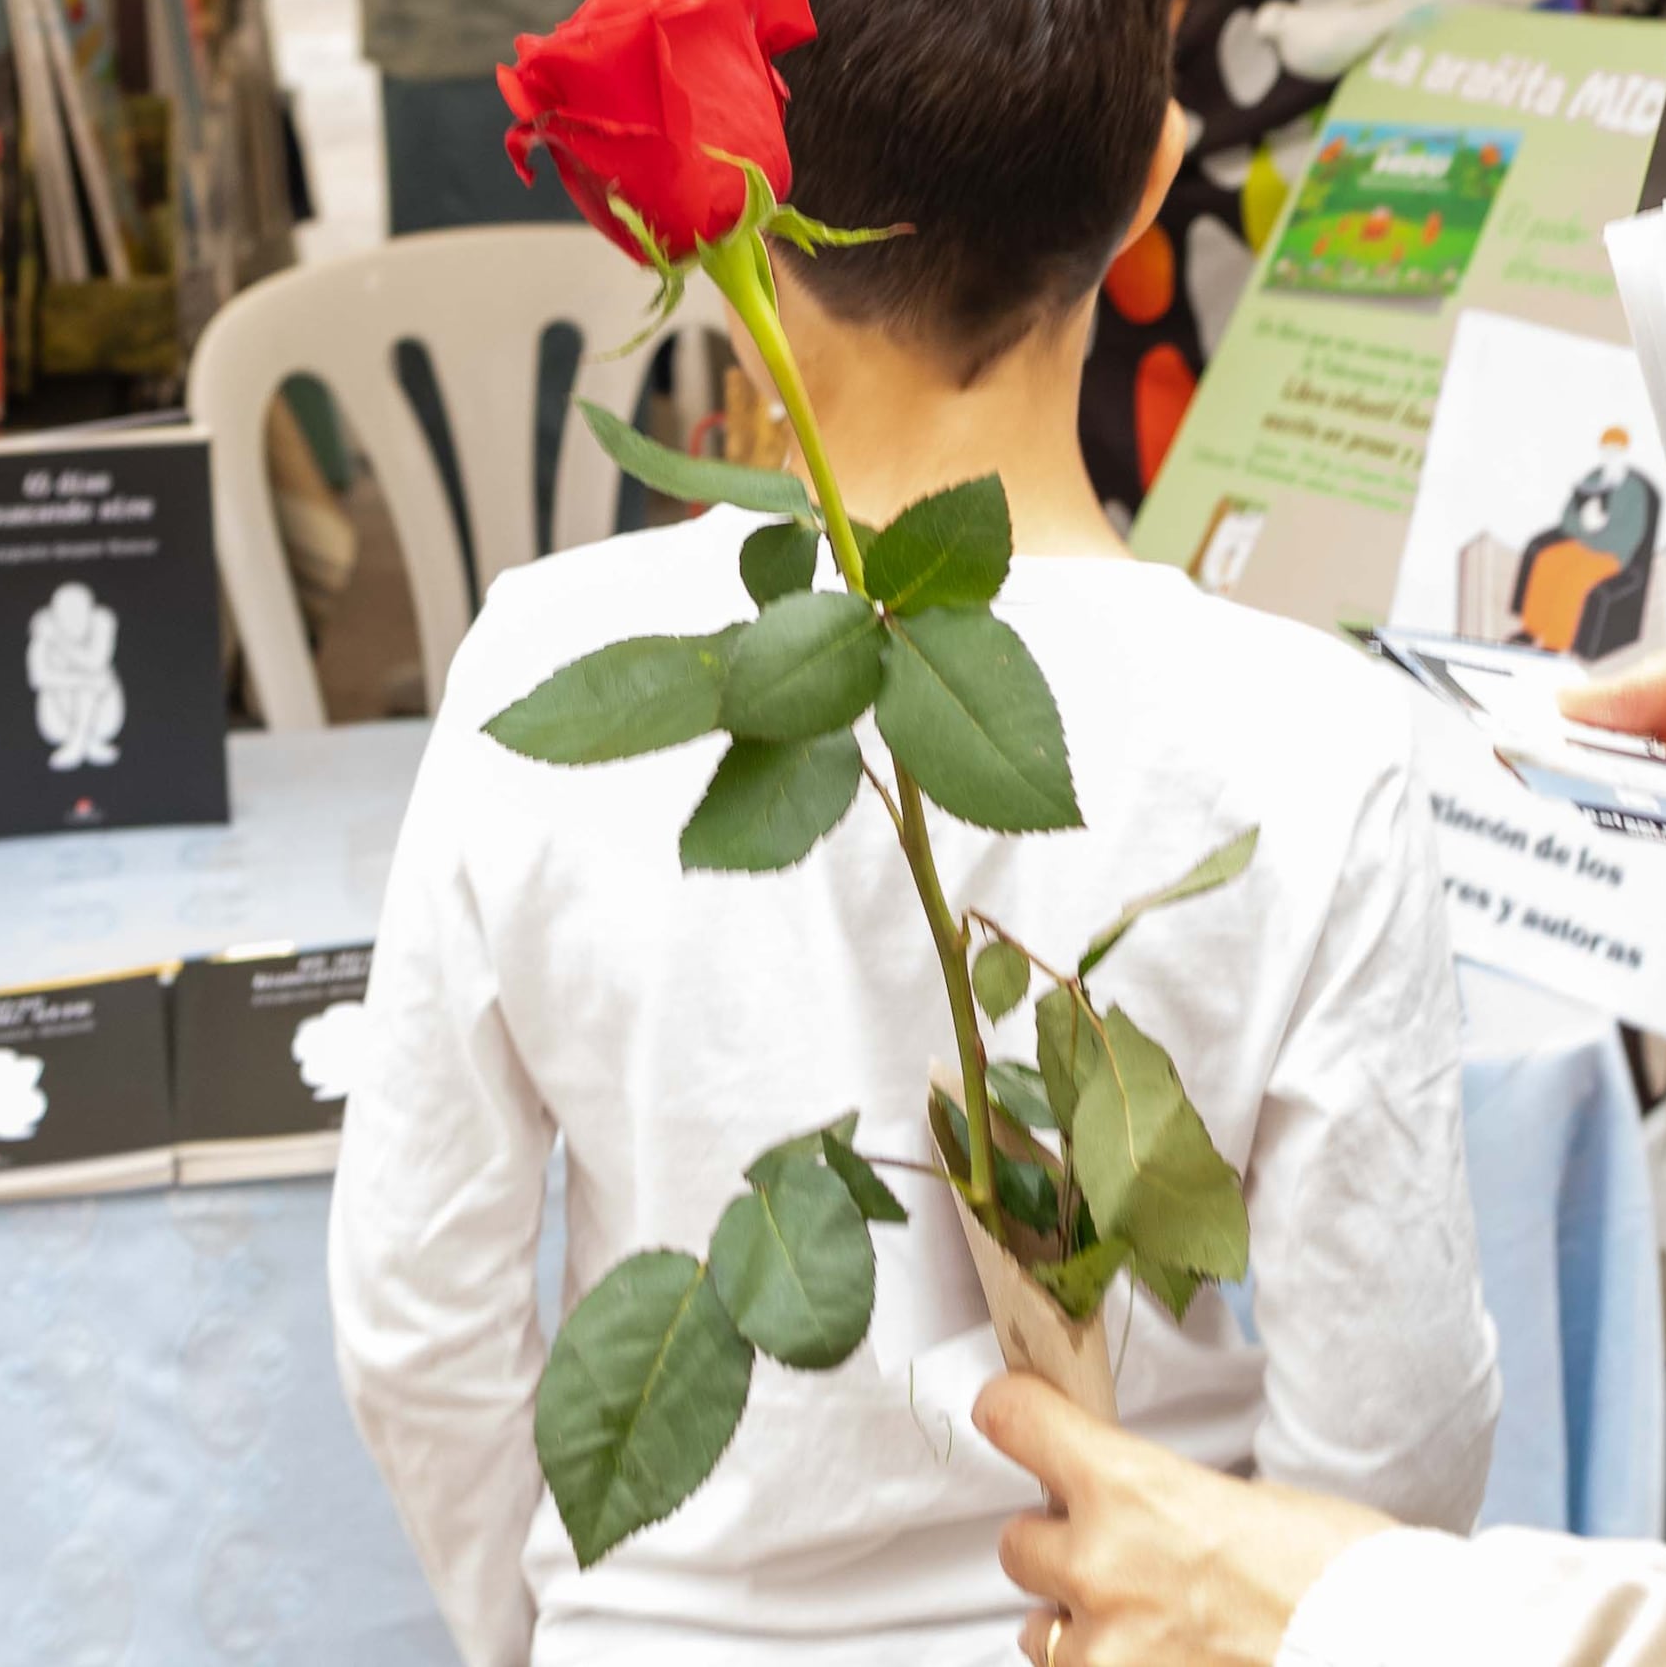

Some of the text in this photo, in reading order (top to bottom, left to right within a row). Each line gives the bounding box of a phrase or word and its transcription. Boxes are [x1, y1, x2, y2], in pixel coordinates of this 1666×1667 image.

[1535, 833, 1571, 867] de
[1577, 846, 1624, 887] los
[1495, 896, 1514, 925] y
[1520, 907, 1643, 968] autoras
